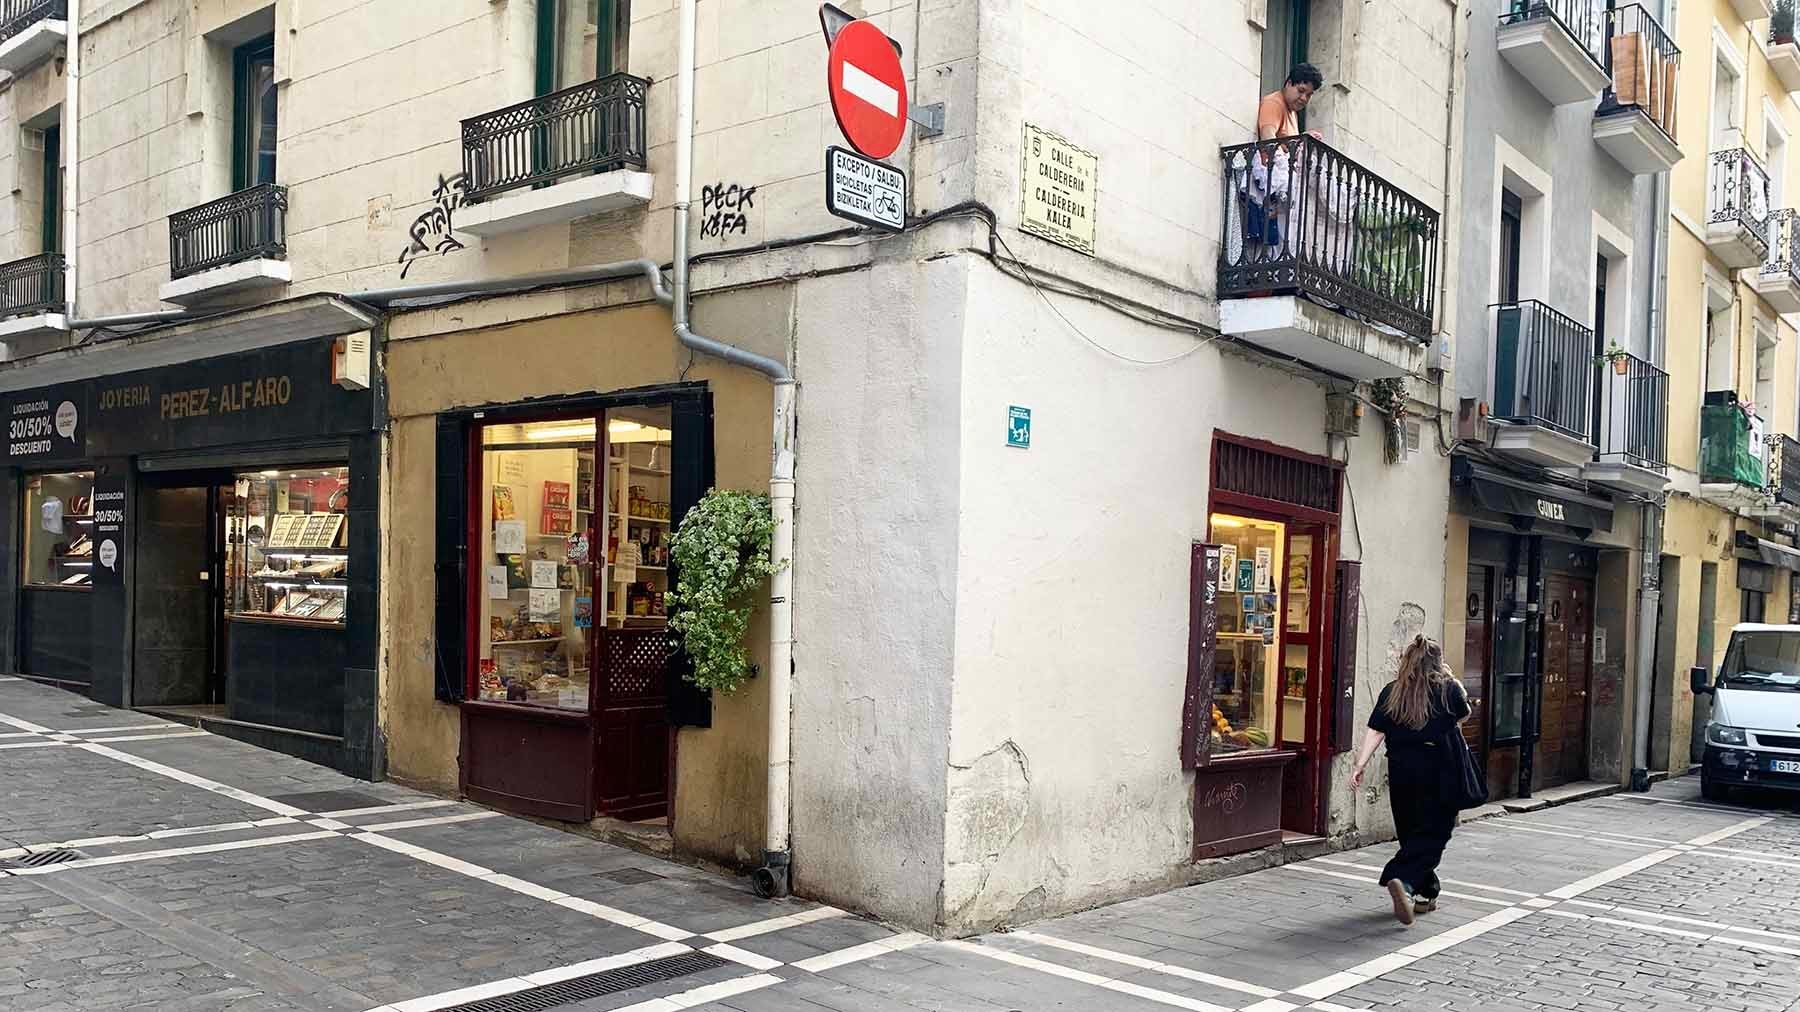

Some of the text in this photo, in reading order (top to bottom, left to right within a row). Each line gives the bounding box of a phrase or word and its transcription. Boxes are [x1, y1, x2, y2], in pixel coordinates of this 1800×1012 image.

[837, 154, 871, 178] EXCEPTO
[872, 168, 876, 180] /
[1051, 148, 1073, 169] CALLE
[836, 173, 873, 195] BICICLETAS
[1039, 163, 1085, 193] CALDERERIA
[837, 192, 872, 212] BIZIKLETAK
[1036, 187, 1086, 219] CALDERERIA
[1046, 208, 1072, 230] KALEA
[100, 385, 151, 410] JOYERIA
[9, 415, 53, 440] 30/50%
[9, 439, 52, 456] DESCUENTO
[95, 509, 124, 523] 30/50%
